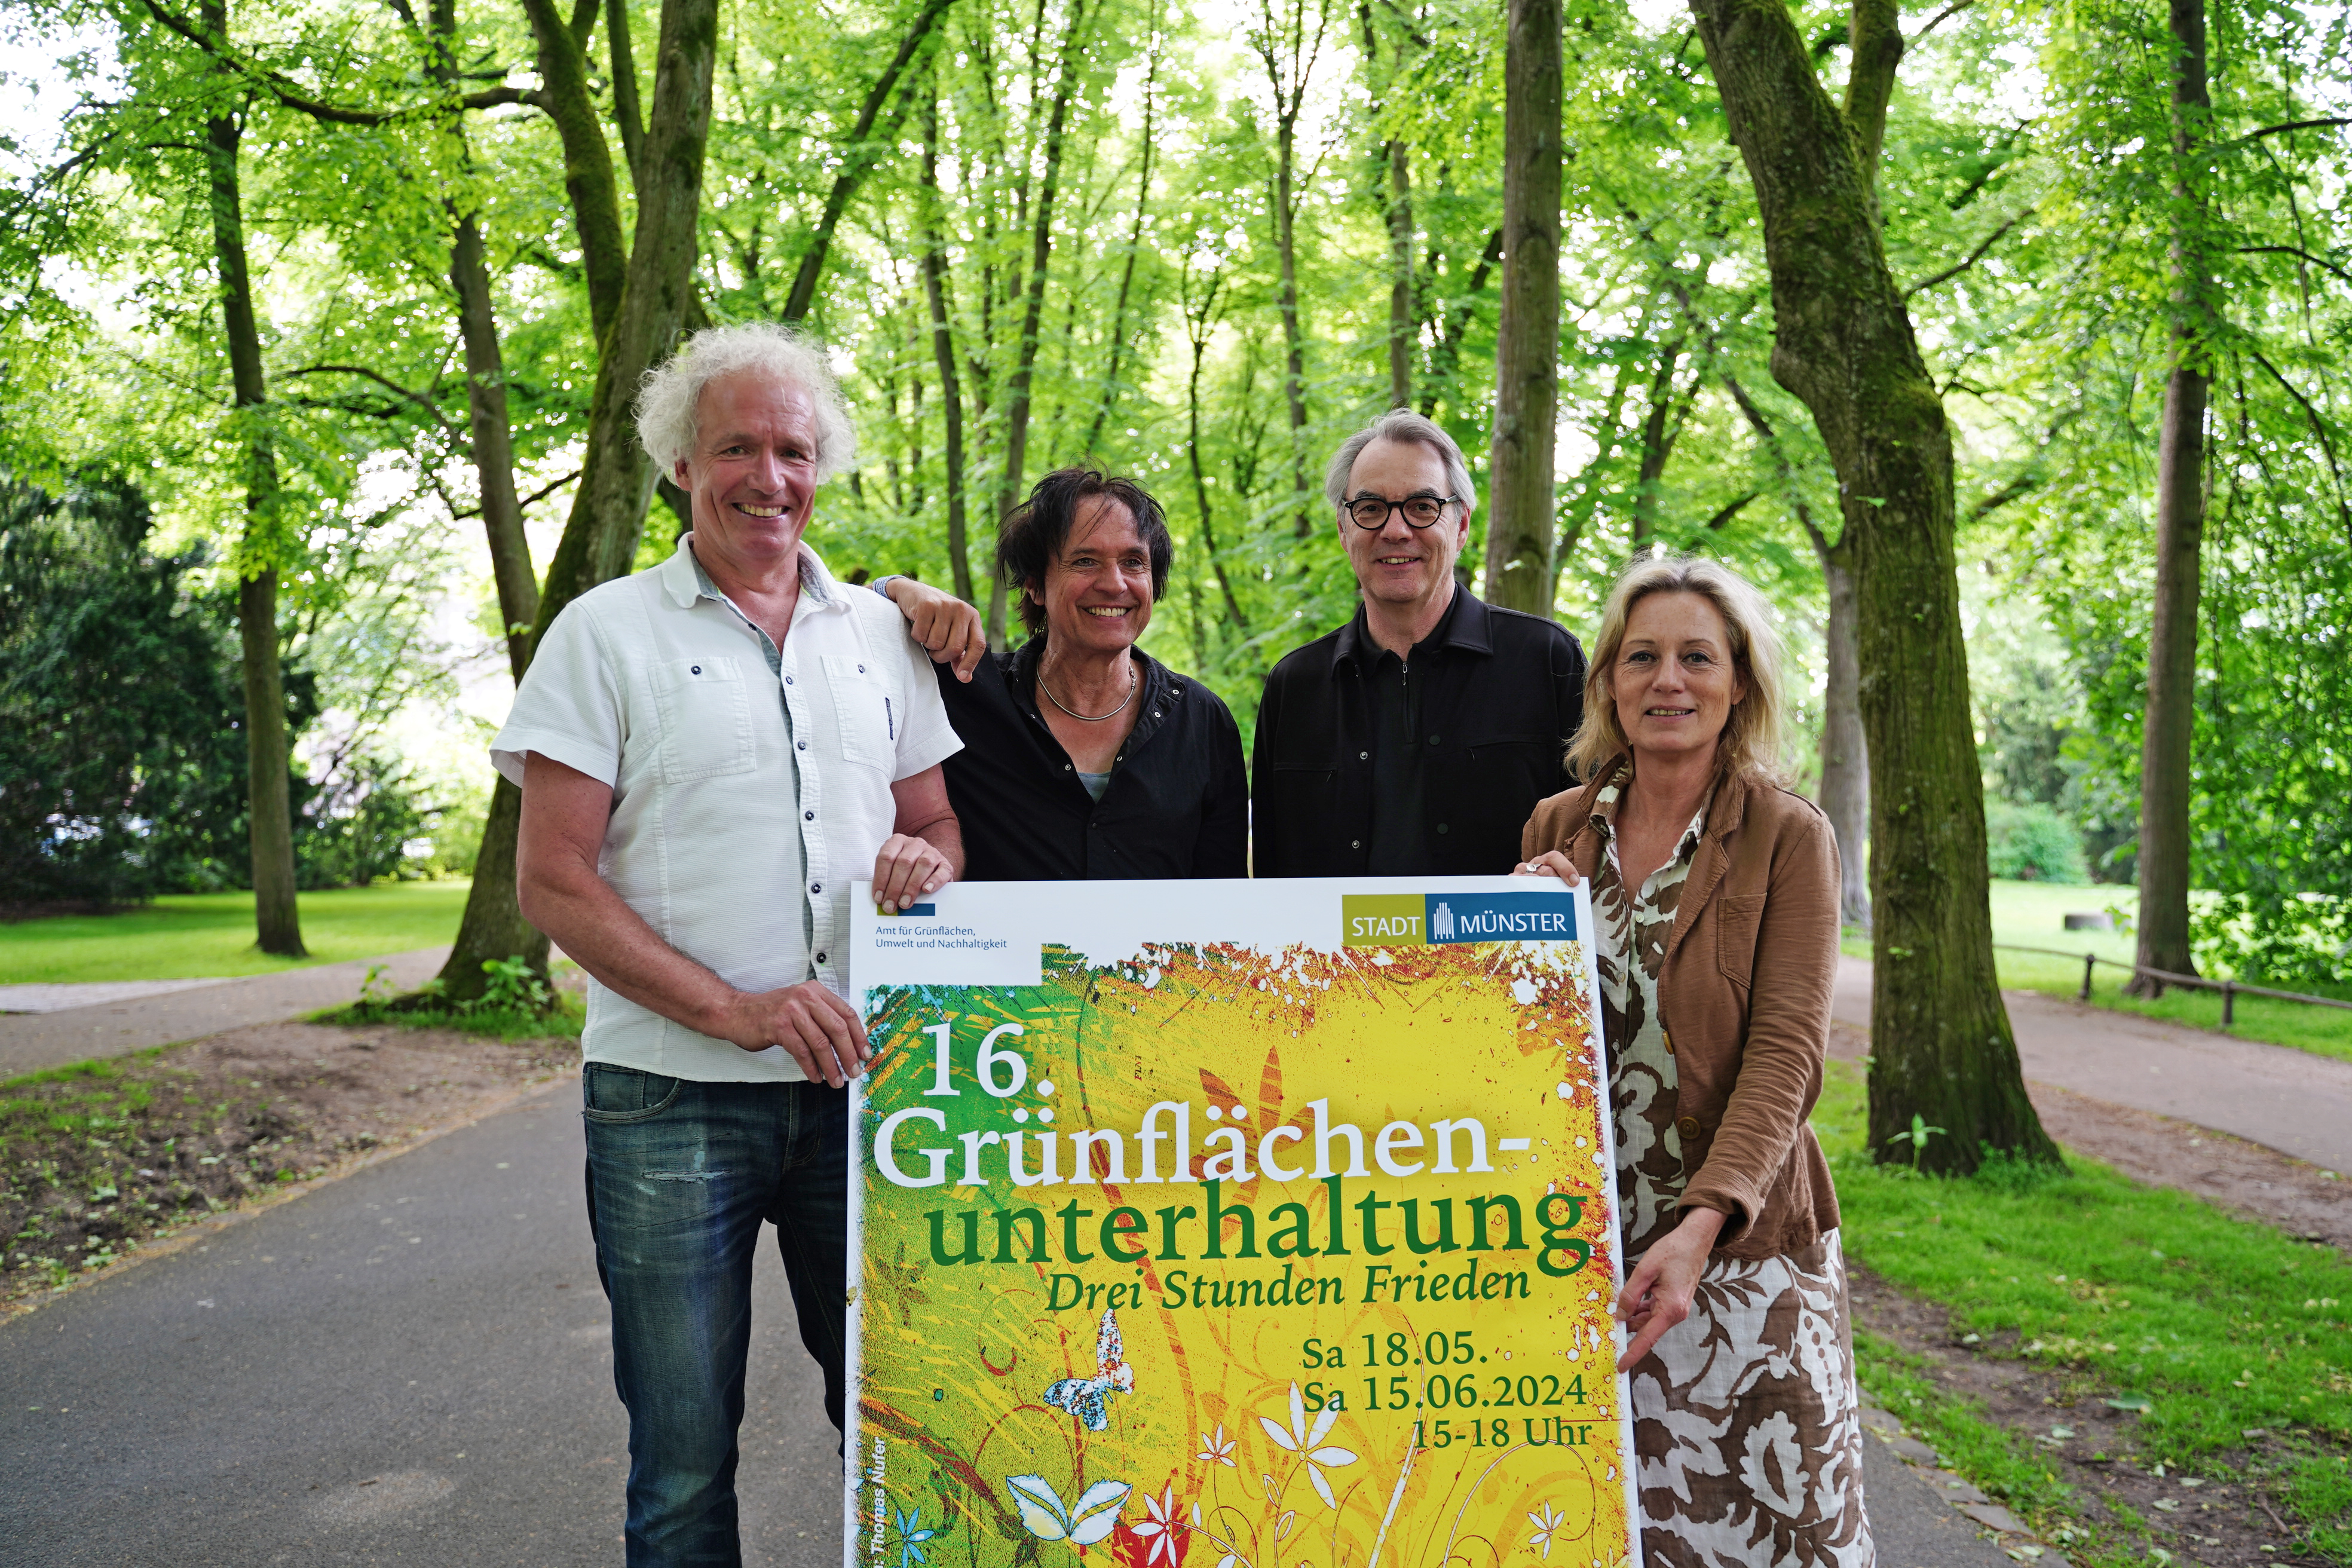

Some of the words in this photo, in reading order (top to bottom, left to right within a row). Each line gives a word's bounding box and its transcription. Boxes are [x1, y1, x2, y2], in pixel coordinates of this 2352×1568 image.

[876, 926, 896, 935] Amt
[899, 926, 912, 935] für
[915, 926, 975, 936] Grünflächen,
[876, 939, 914, 948] Umwelt
[917, 939, 935, 948] und
[938, 939, 1007, 950] Nachhaltigkeit
[1353, 917, 1420, 936] STADT
[1462, 914, 1566, 933] MÜNSTER
[923, 1023, 1054, 1097] 16.
[874, 1098, 1530, 1187] Grünflächen-
[923, 1174, 1590, 1277] unterhaltung
[1045, 1269, 1144, 1310] Drei
[1162, 1264, 1344, 1308] Stunden
[1361, 1258, 1530, 1303] Frieden
[1303, 1339, 1346, 1368] Sa
[1362, 1331, 1487, 1366] 18.05.
[1305, 1383, 1348, 1411] Sa
[1364, 1374, 1588, 1409] 15.06.2024
[1413, 1419, 1509, 1447] 15-18
[1523, 1416, 1592, 1446] Uhr
[871, 1436, 885, 1483] Nufer
[871, 1487, 885, 1554] Thomas
